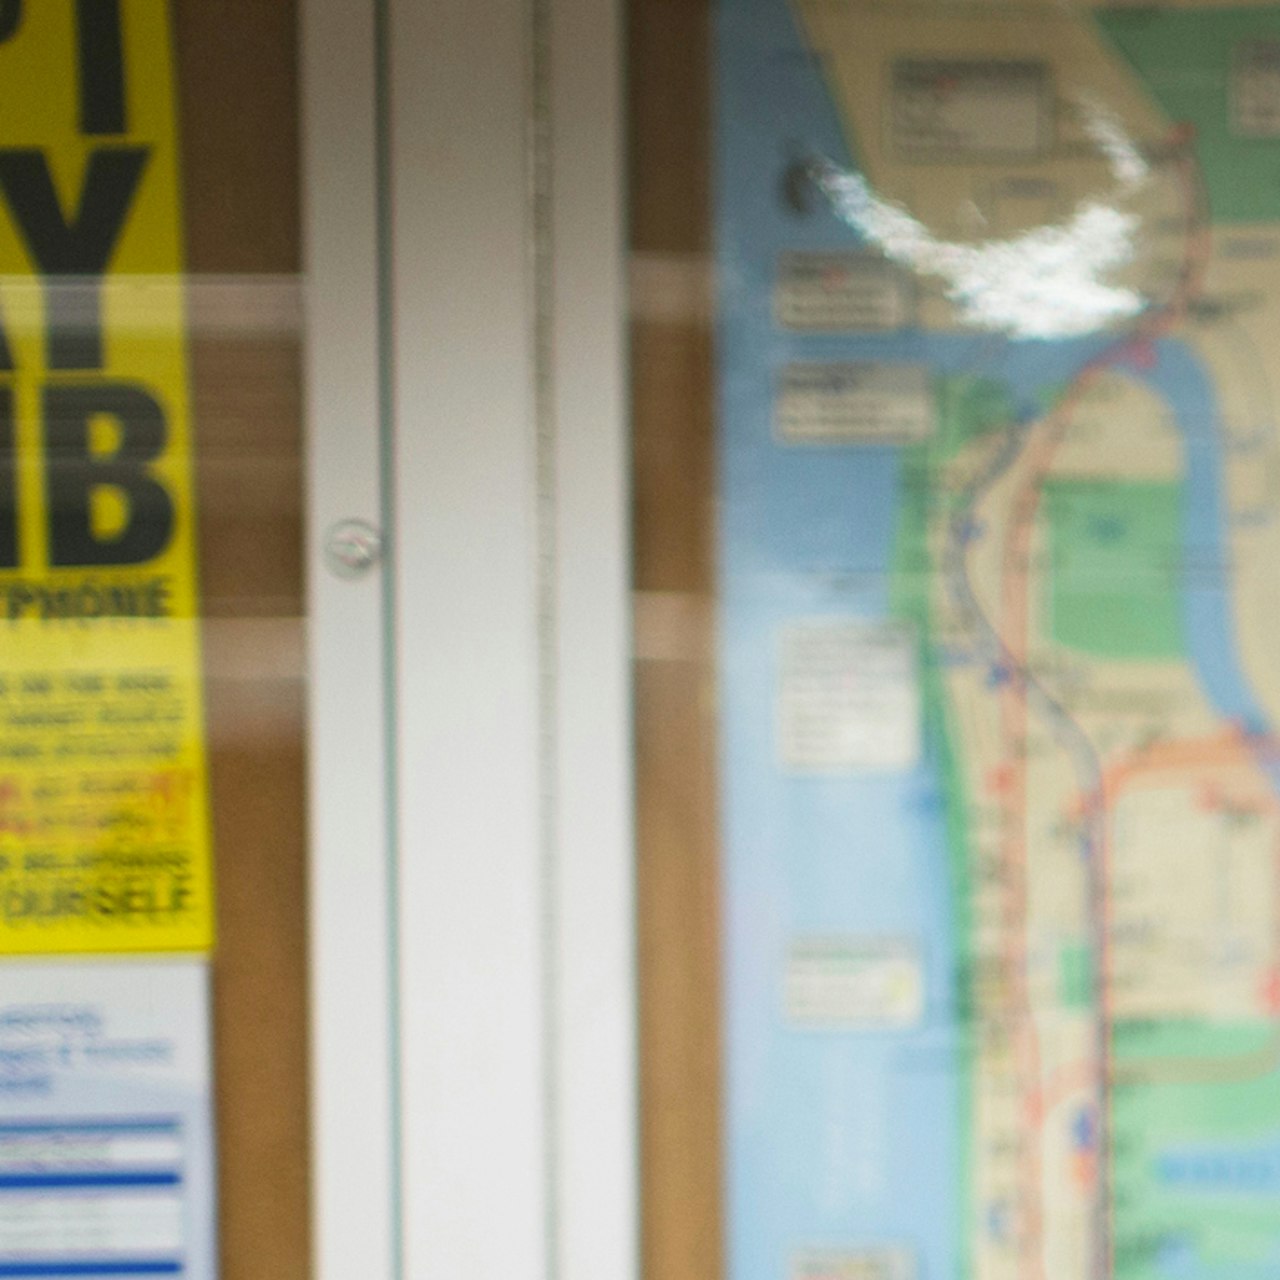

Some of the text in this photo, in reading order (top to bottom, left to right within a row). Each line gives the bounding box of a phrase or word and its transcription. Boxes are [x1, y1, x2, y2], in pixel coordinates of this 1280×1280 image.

[0, 146, 153, 371] Y
[0, 379, 176, 567] B
[0, 576, 172, 624] PHONE
[0, 876, 191, 922] OURSELF
